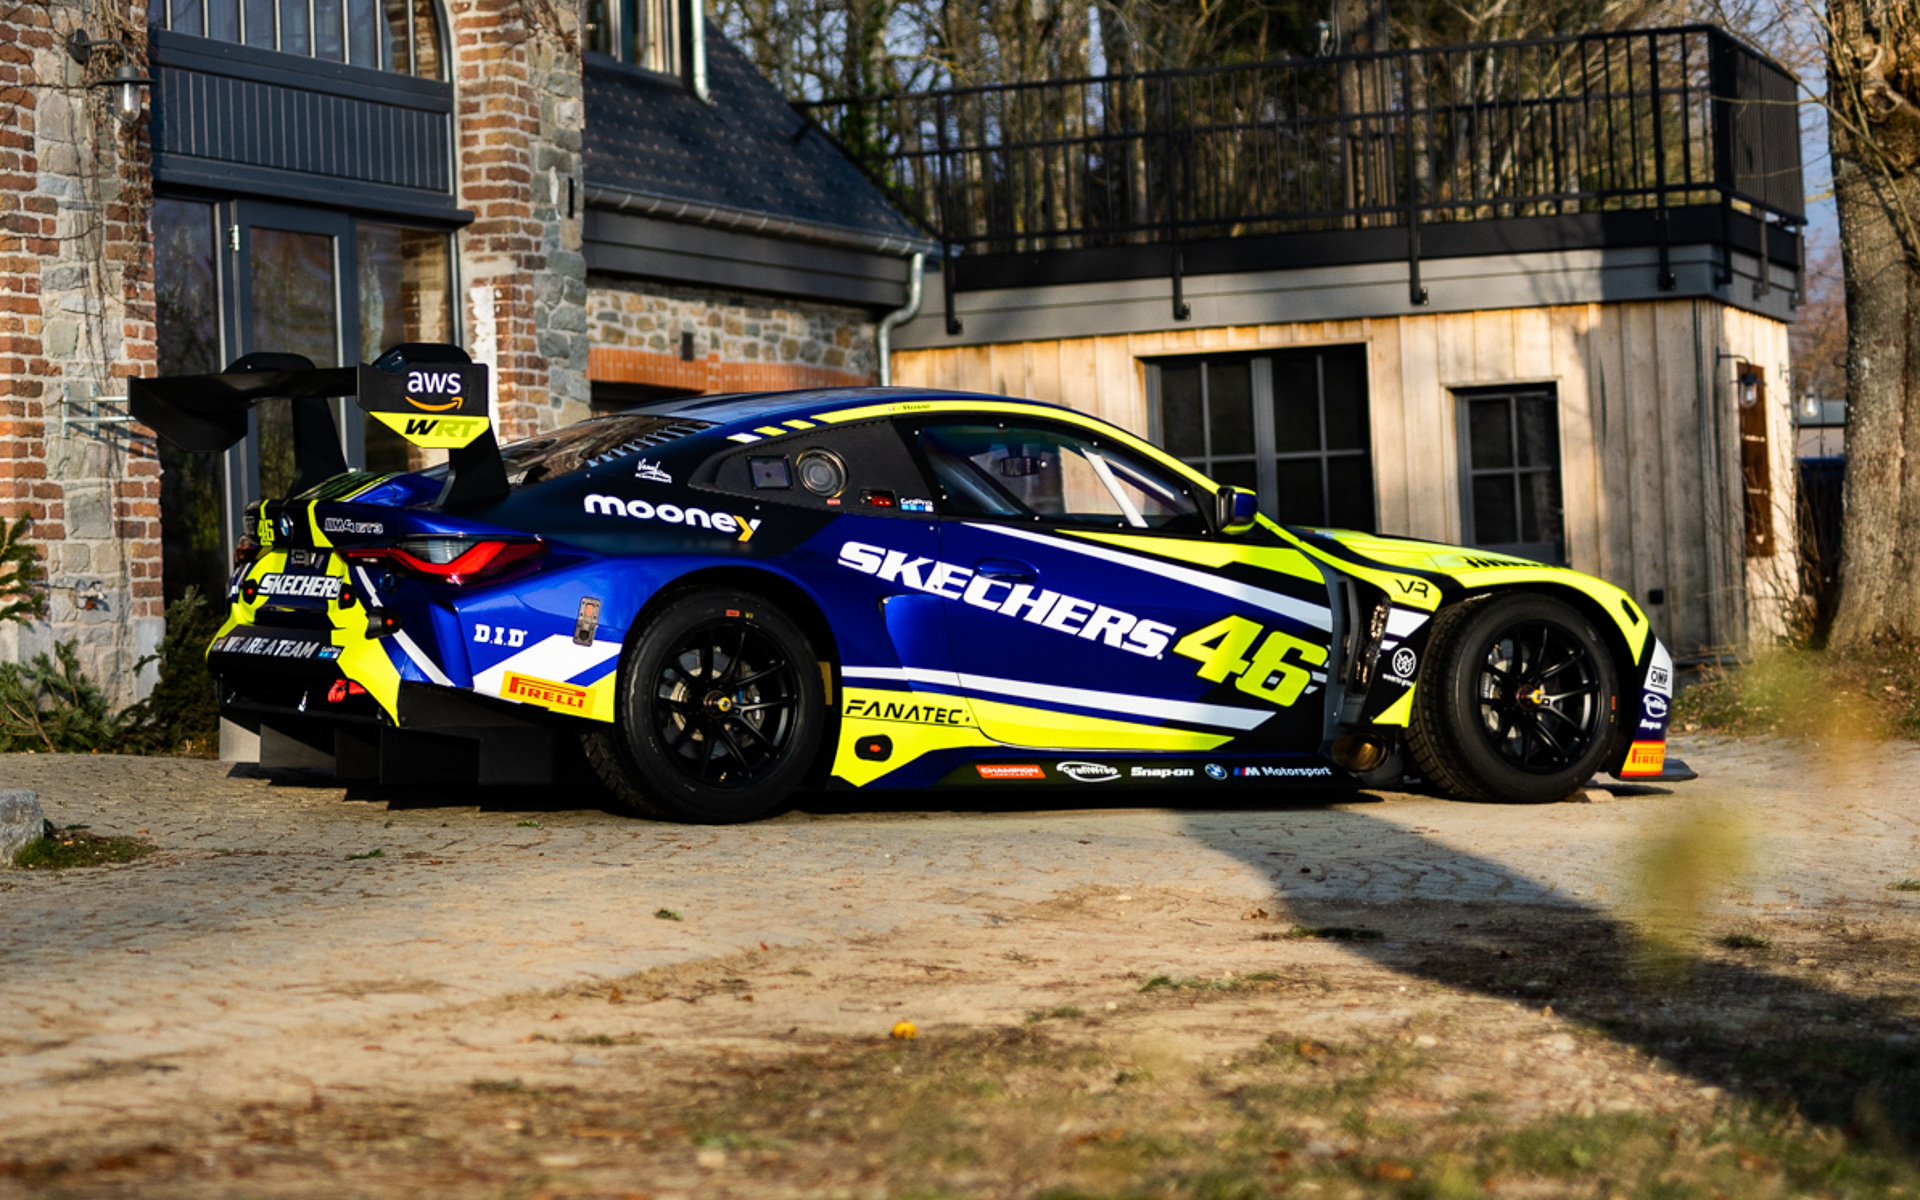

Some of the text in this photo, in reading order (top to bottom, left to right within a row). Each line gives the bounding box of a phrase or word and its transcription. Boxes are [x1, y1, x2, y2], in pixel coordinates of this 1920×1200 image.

[407, 371, 461, 394] aws
[405, 418, 479, 437] WRT
[583, 493, 761, 542] mooney
[257, 519, 275, 544] 46
[258, 574, 341, 597] SKECHERS
[1395, 579, 1429, 598] VR
[223, 636, 245, 652] WE
[239, 637, 269, 655] ARE
[262, 639, 274, 655] A
[273, 640, 320, 658] TEAM
[1173, 614, 1328, 707] 46
[508, 676, 586, 709] PIRELLI
[845, 699, 963, 724] FANATEC
[980, 766, 1039, 774] CHAMPION
[1131, 766, 1194, 778] Snap-on
[1261, 766, 1332, 778] Motorsport
